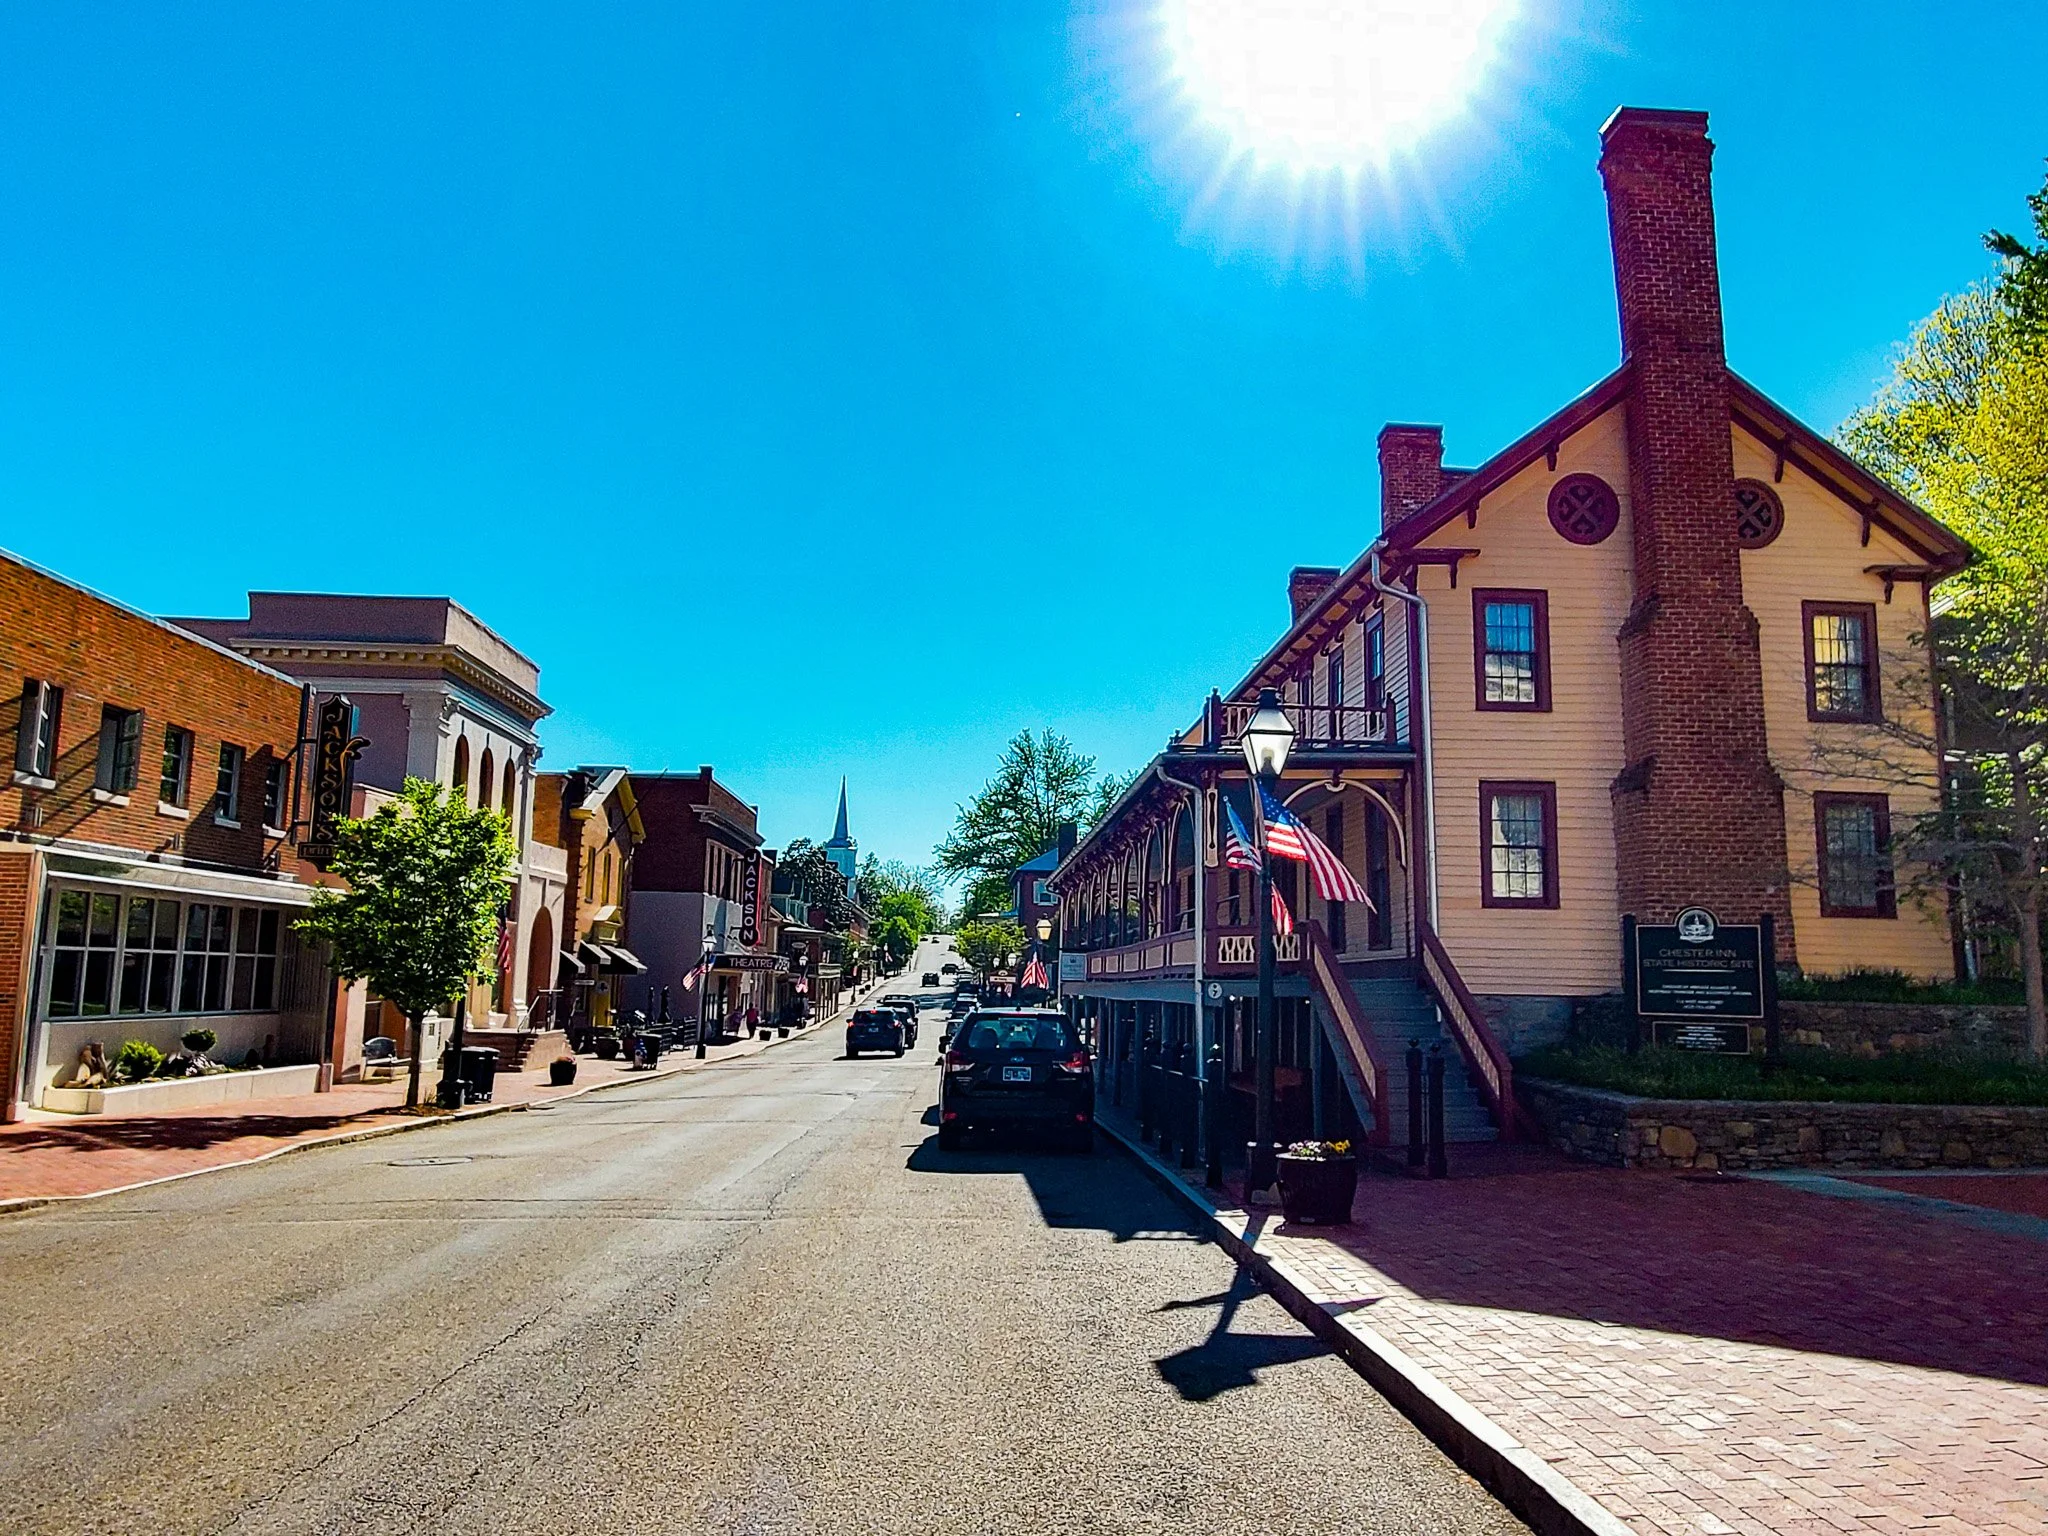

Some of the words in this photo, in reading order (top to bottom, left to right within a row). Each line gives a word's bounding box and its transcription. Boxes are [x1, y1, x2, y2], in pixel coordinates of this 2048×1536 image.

[743, 853, 756, 940] JACKSON
[1658, 948, 1714, 958] CHESTER
[1715, 948, 1737, 958] INN
[1642, 958, 1675, 968] STATE
[1676, 958, 1728, 968] HISTORIC
[1730, 959, 1754, 969] SITE
